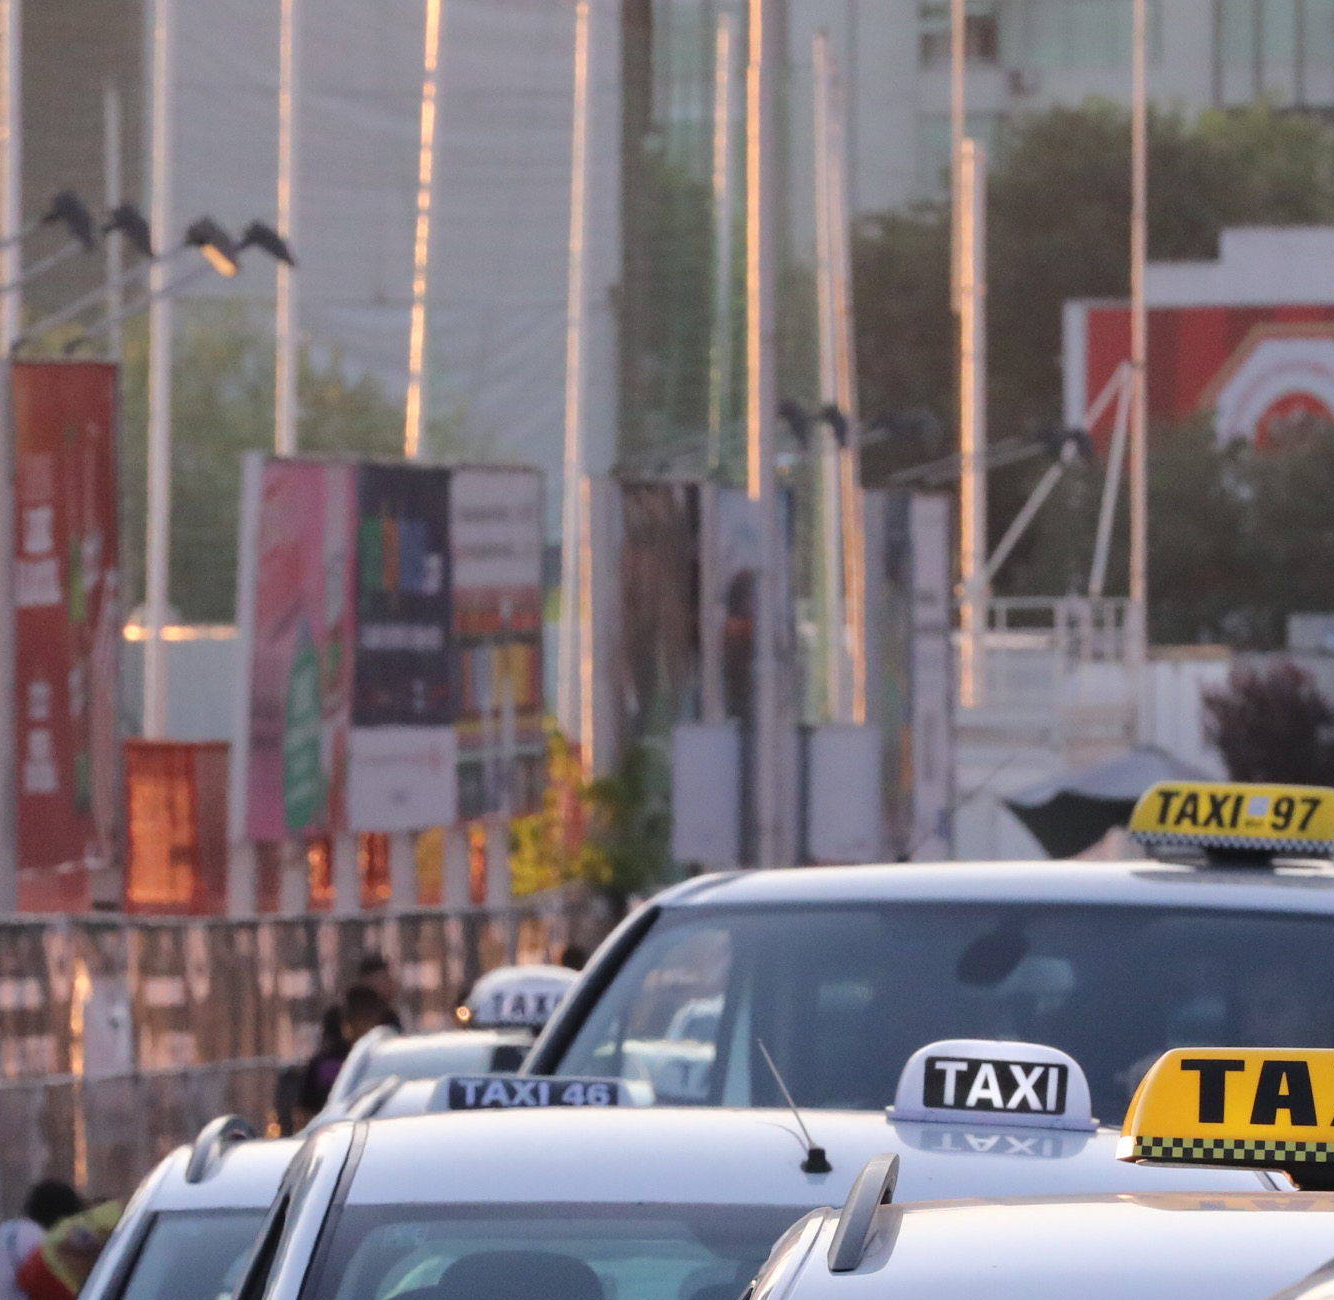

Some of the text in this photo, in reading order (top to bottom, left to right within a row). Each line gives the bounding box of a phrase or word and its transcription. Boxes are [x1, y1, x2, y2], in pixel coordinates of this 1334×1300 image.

[1158, 789, 1322, 833] TAXI 97
[459, 1079, 610, 1106] TAXI 46
[935, 1060, 1058, 1112] TAXI
